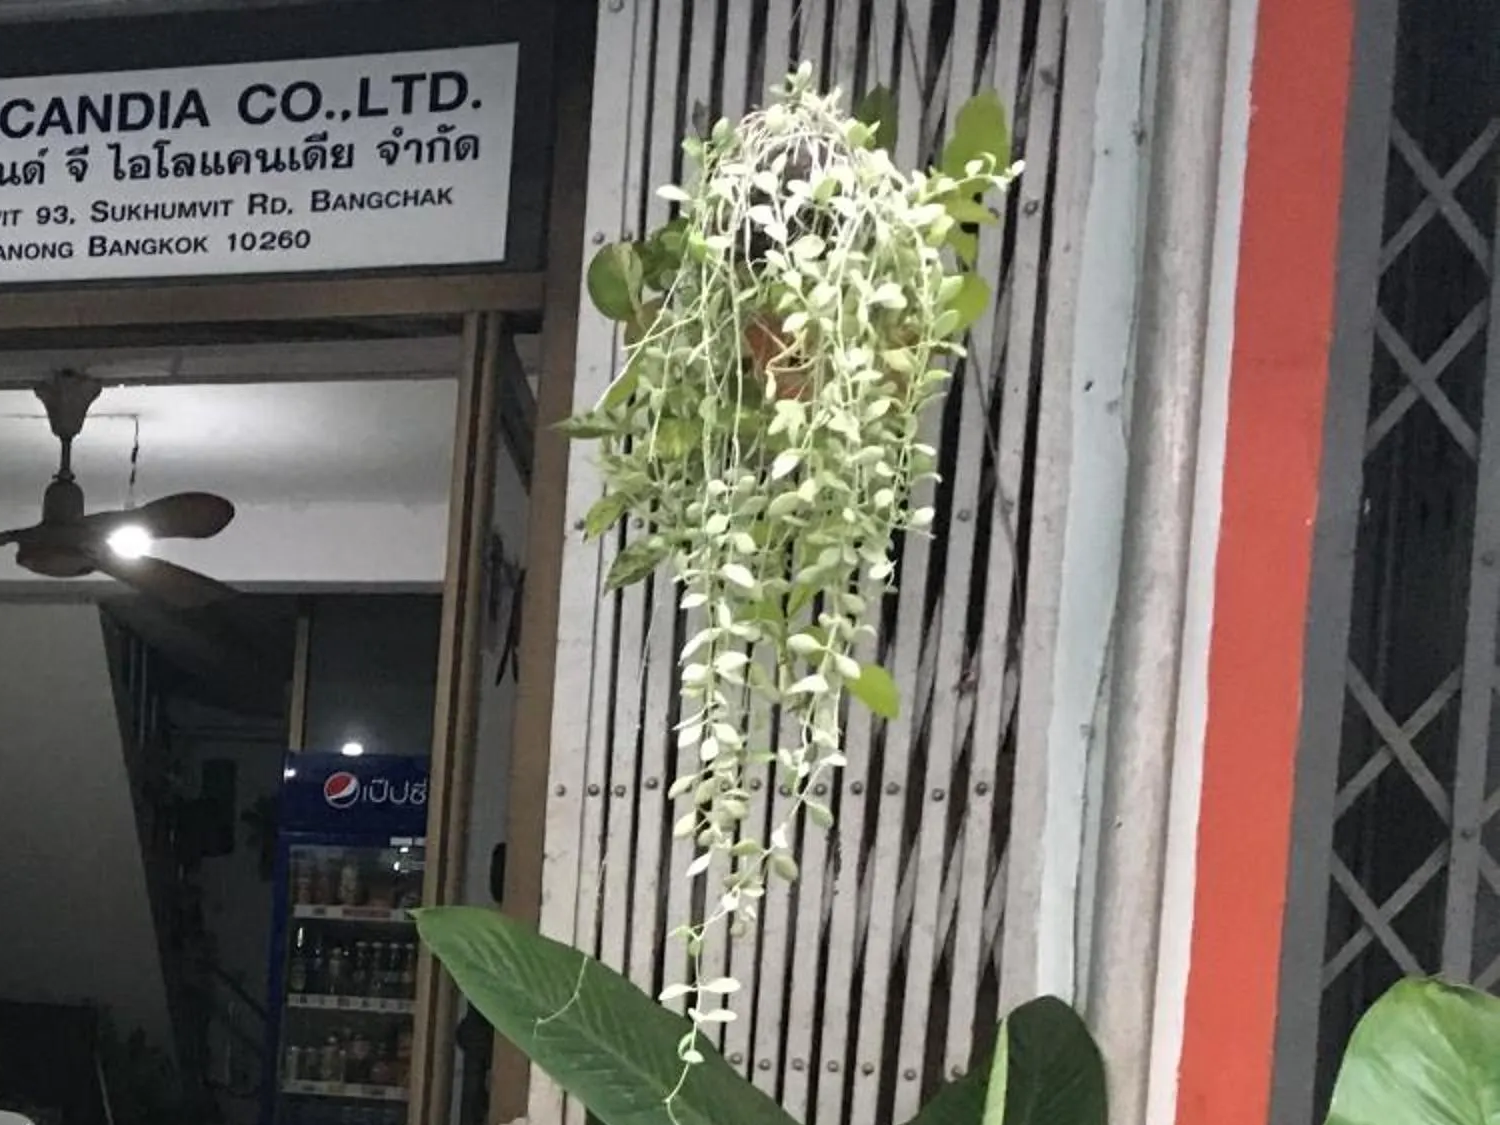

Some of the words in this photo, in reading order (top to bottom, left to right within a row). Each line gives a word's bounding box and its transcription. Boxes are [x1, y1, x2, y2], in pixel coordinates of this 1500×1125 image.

[66, 144, 89, 182] จี
[108, 131, 354, 181] ไอโลแคนเดีย
[376, 124, 479, 166] จำกัด
[90, 199, 234, 223] SUKHUMVIT
[310, 187, 453, 212] BANGCHAK
[88, 236, 208, 257] BANGKOK
[228, 229, 311, 252] 10260
